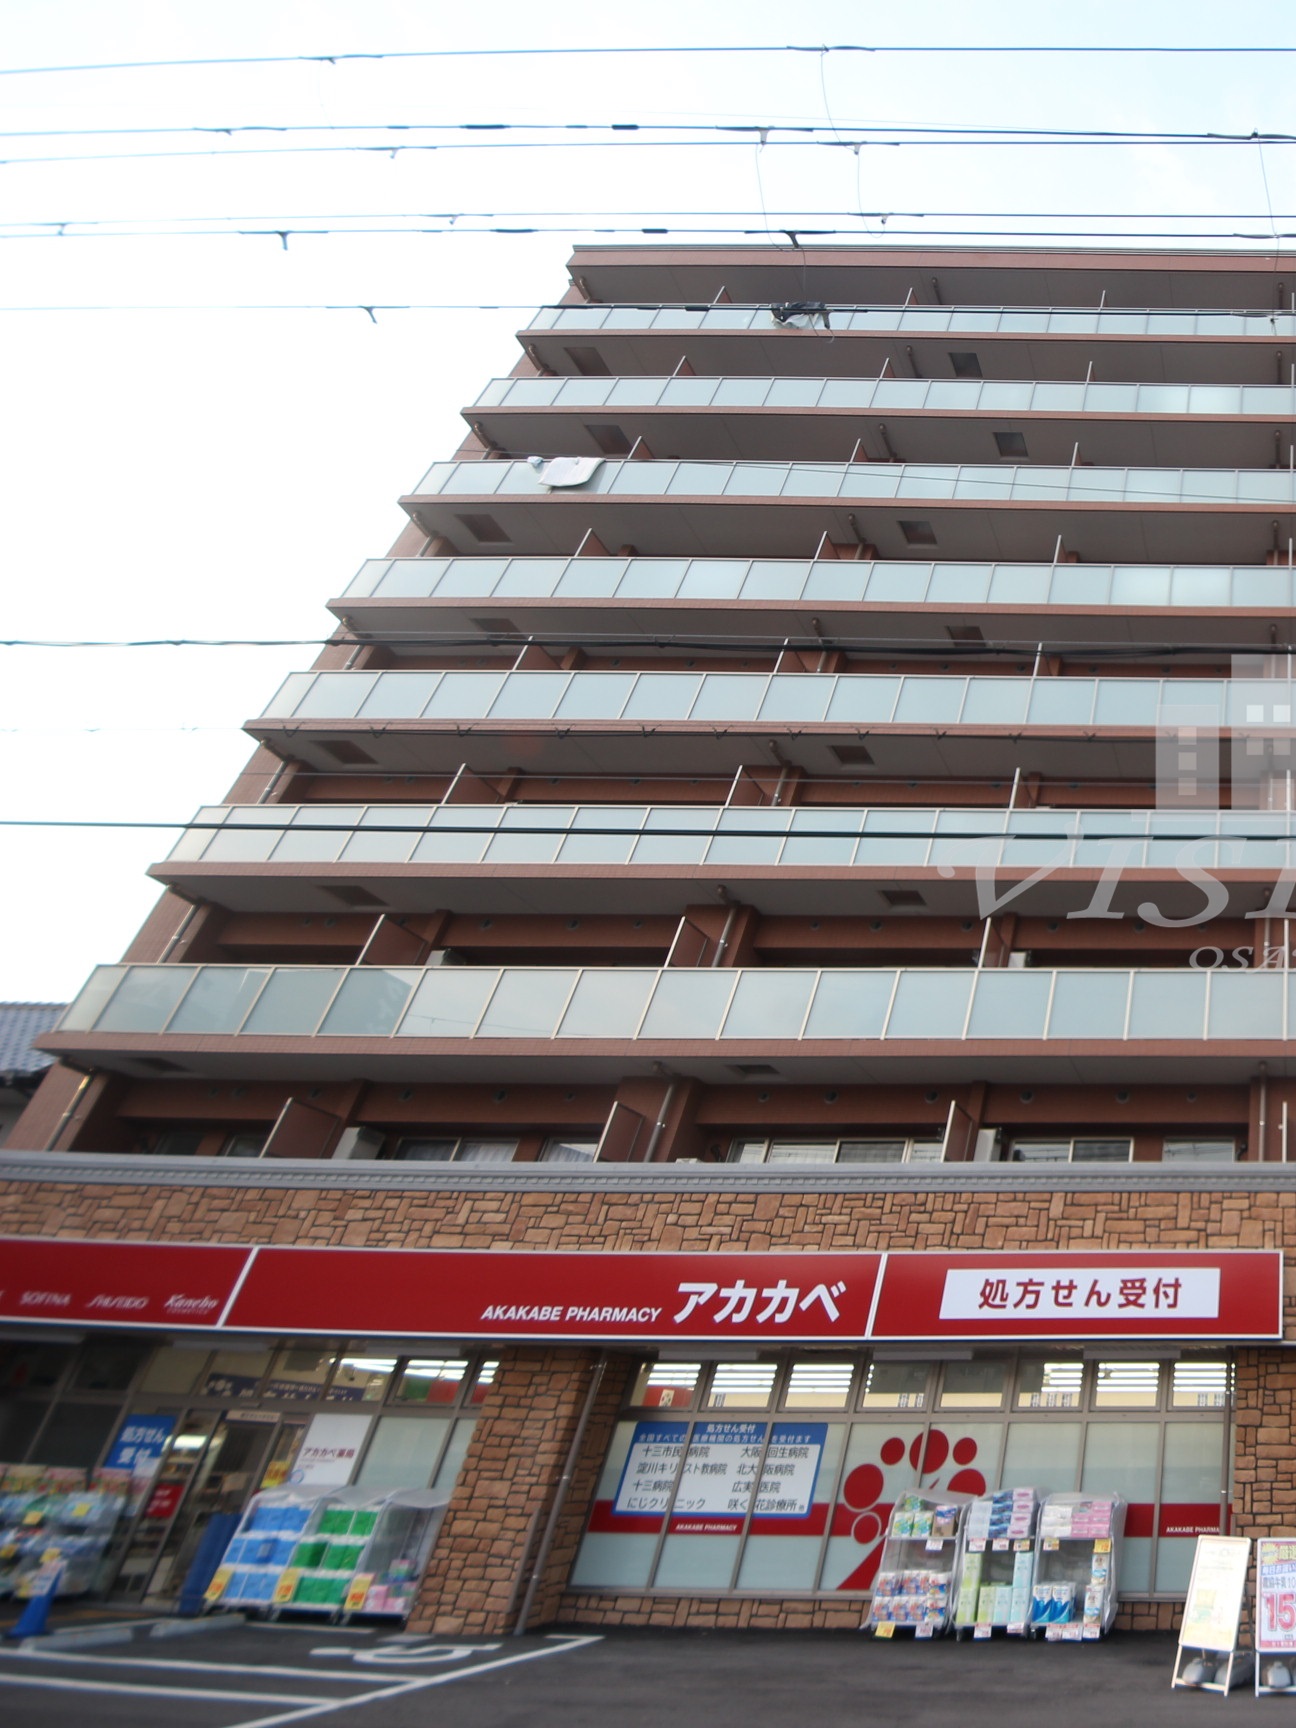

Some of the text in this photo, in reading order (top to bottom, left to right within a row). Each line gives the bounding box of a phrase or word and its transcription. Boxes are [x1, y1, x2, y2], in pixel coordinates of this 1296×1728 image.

[163, 1292, 219, 1310] Kanebo
[978, 1277, 1183, 1310] 処方せん受付
[673, 1279, 847, 1324] アカカベ
[480, 1304, 662, 1323] AKAKABE PHARMACY
[119, 1425, 166, 1445] 処方せん
[705, 1423, 756, 1434] 処方せん受付
[116, 1445, 151, 1465] 受付
[740, 1446, 810, 1459] 大阪回生病院
[736, 1463, 796, 1476] 北大阪病院
[633, 1480, 674, 1492] 十三病院
[626, 1497, 706, 1510] にじクリニック
[675, 1523, 738, 1532] AKAKABE PHARMACY
